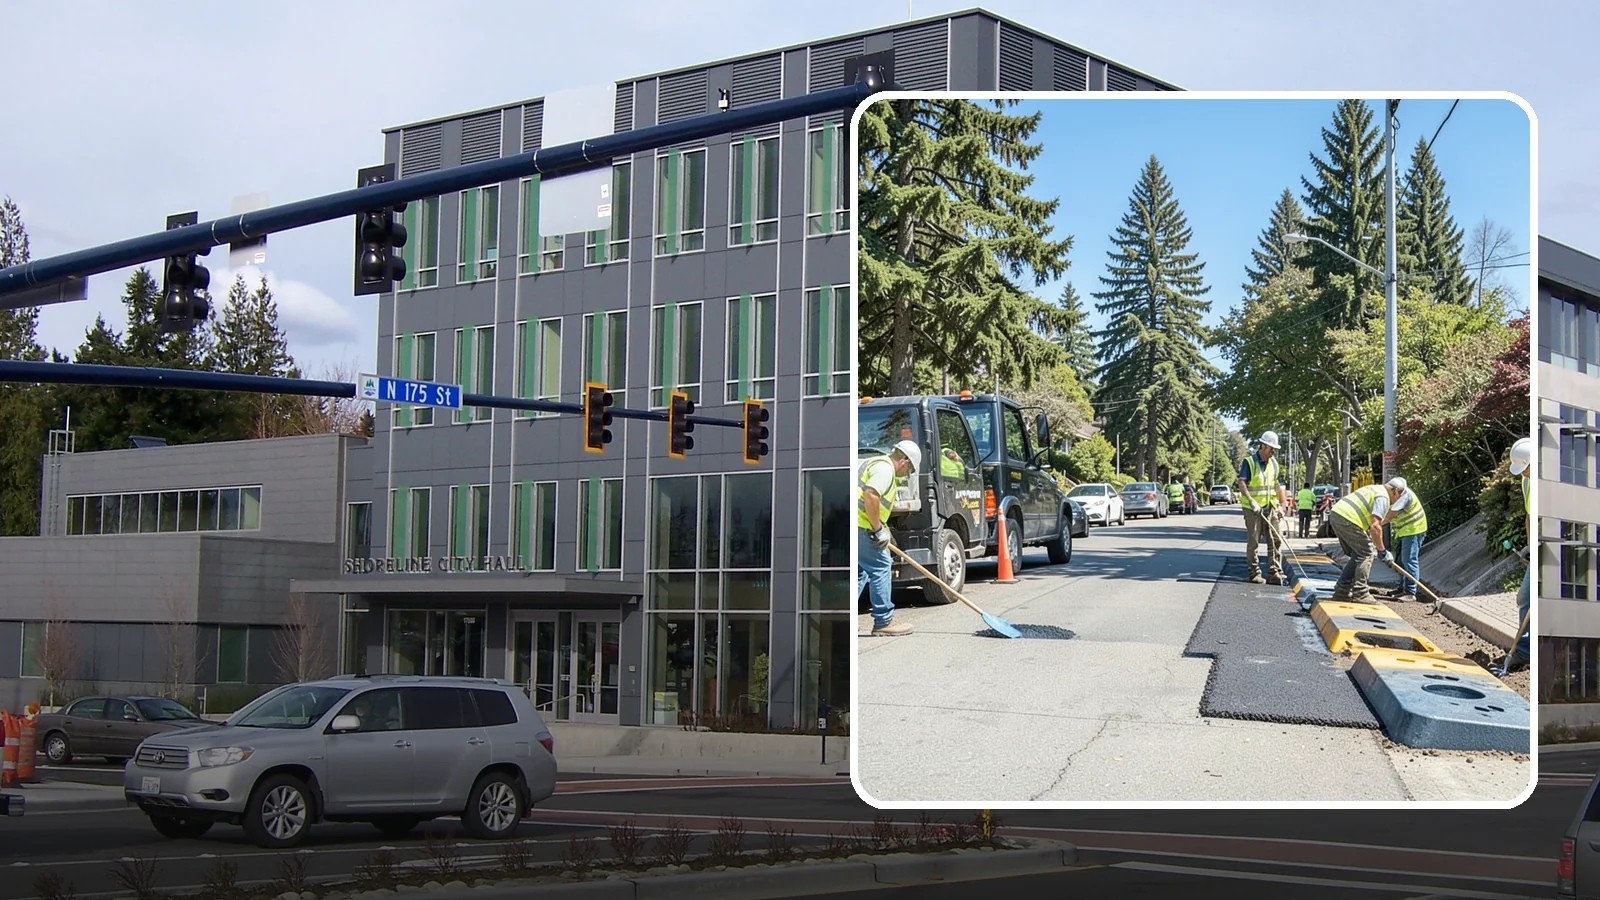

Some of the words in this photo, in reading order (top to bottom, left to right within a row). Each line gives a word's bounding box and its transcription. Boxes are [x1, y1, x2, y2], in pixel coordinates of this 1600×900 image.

[387, 380, 396, 399] N
[405, 382, 427, 403] 175
[436, 386, 451, 406] St
[344, 556, 432, 574] SHORELINE
[438, 556, 476, 572] CITY
[483, 555, 526, 571] HALL
